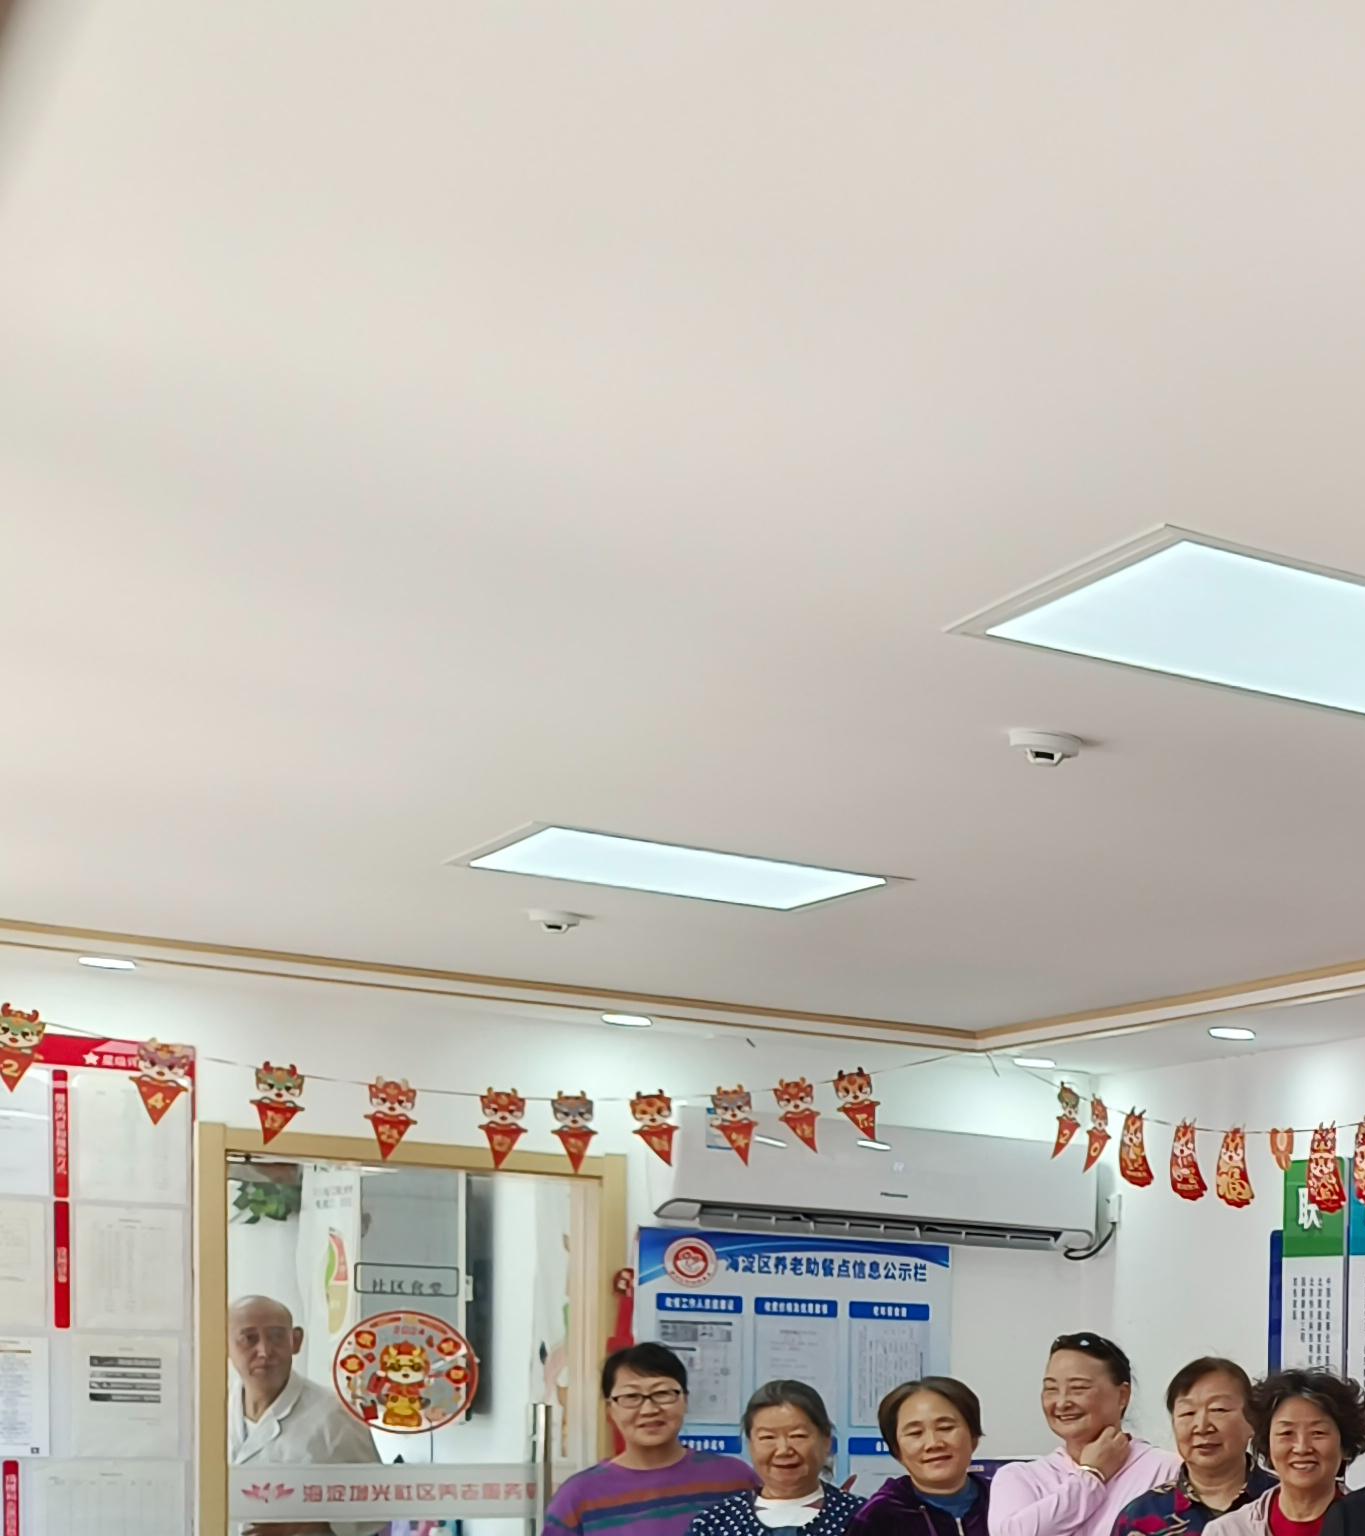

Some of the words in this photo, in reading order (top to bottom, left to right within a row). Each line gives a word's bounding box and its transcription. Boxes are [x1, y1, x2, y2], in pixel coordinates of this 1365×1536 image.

[3, 1060, 19, 1076] 2
[148, 1092, 164, 1109] 4
[1059, 1129, 1071, 1144] 2
[1090, 1144, 1100, 1157] 0
